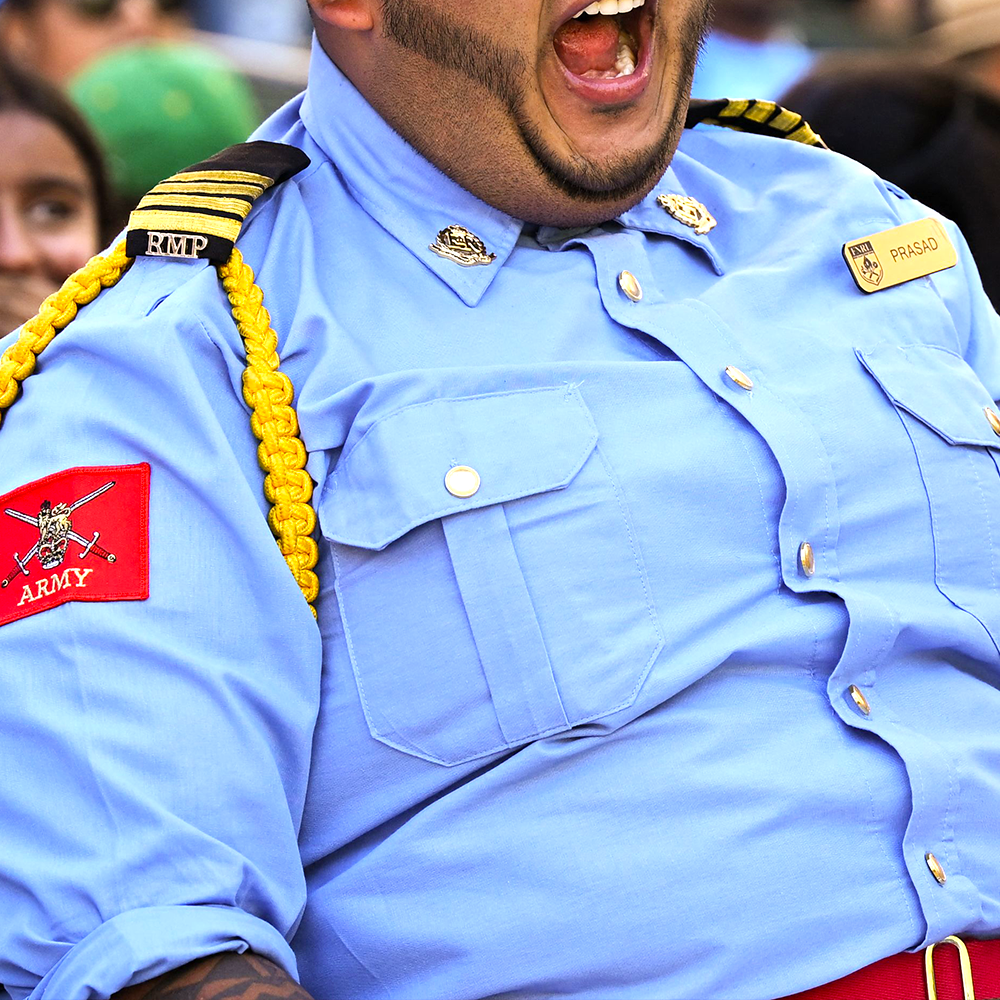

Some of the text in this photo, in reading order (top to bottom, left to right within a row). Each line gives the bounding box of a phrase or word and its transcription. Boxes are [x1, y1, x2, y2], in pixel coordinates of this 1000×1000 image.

[145, 231, 208, 259] RMP
[890, 237, 939, 263] PRASAD
[17, 567, 94, 606] ARMY
